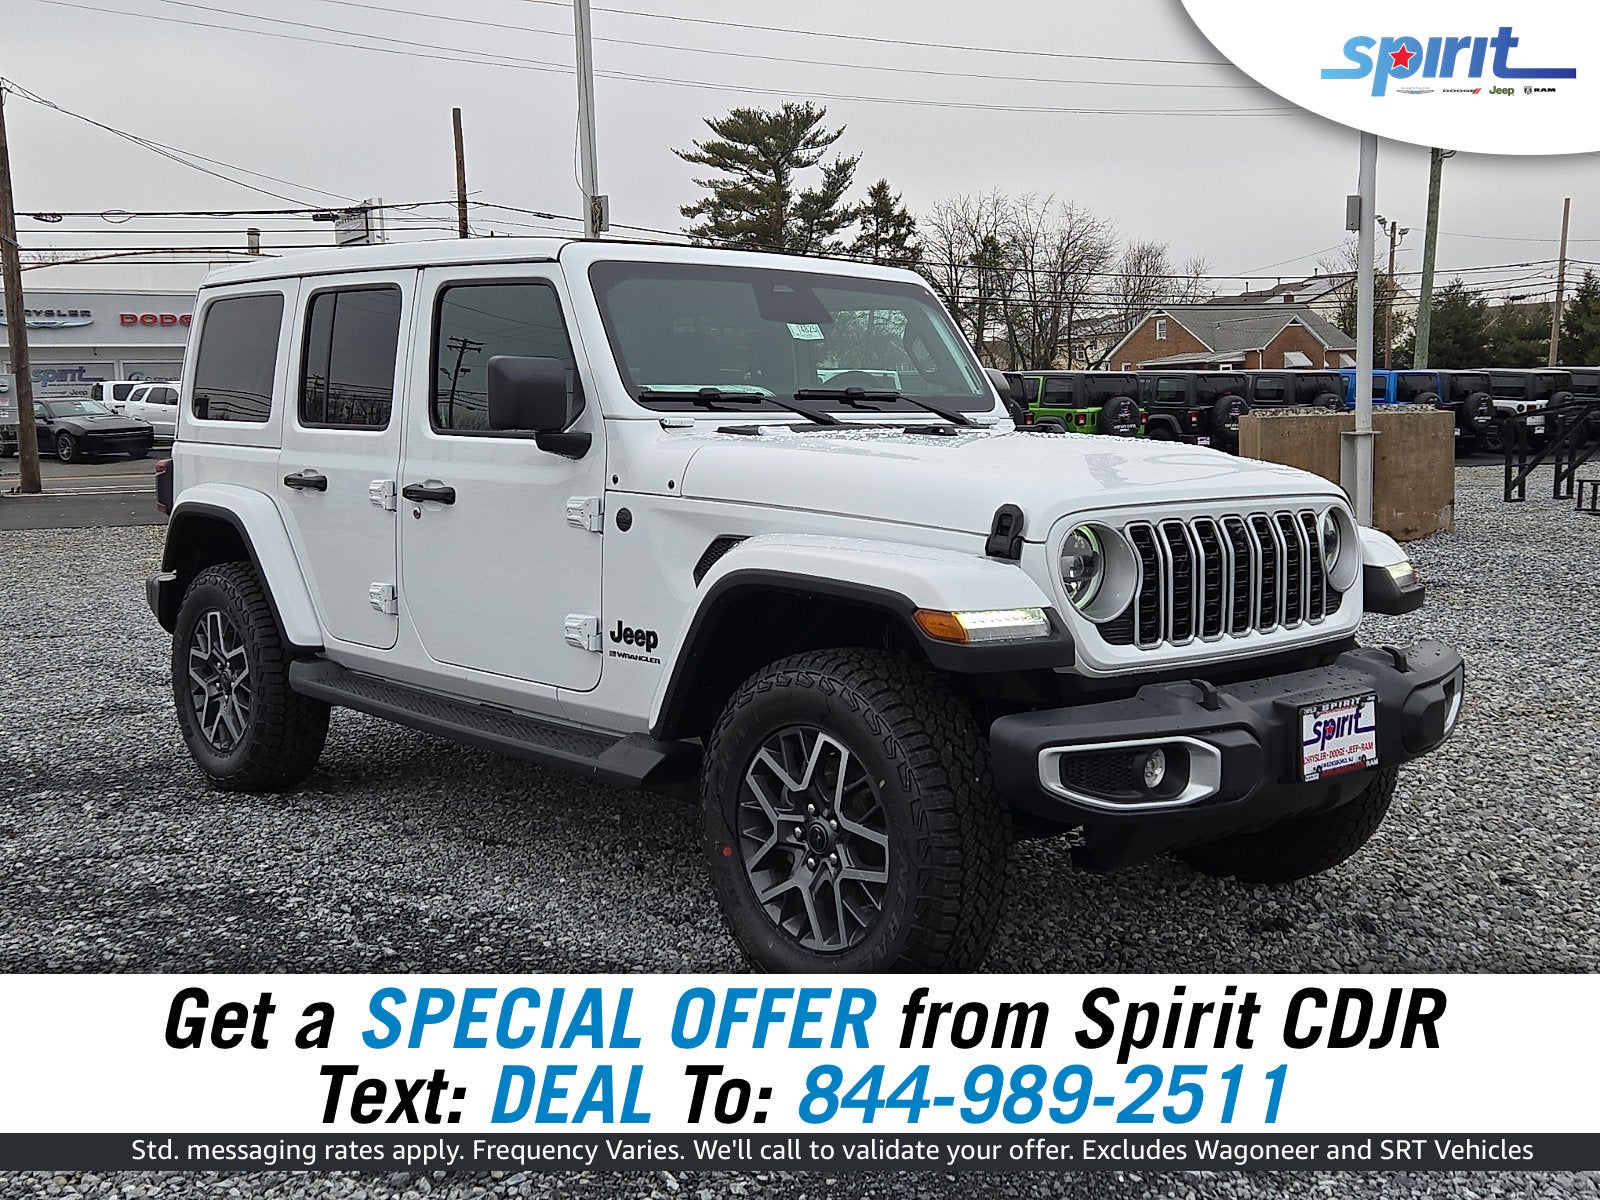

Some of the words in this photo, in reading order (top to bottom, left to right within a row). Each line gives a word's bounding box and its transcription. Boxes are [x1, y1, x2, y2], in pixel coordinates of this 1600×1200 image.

[0, 309, 92, 317] RYSLER
[610, 619, 659, 653] Jeep
[616, 651, 661, 664] WRANGLER
[1321, 696, 1361, 712] SPIRIT
[1303, 708, 1376, 751] spirit
